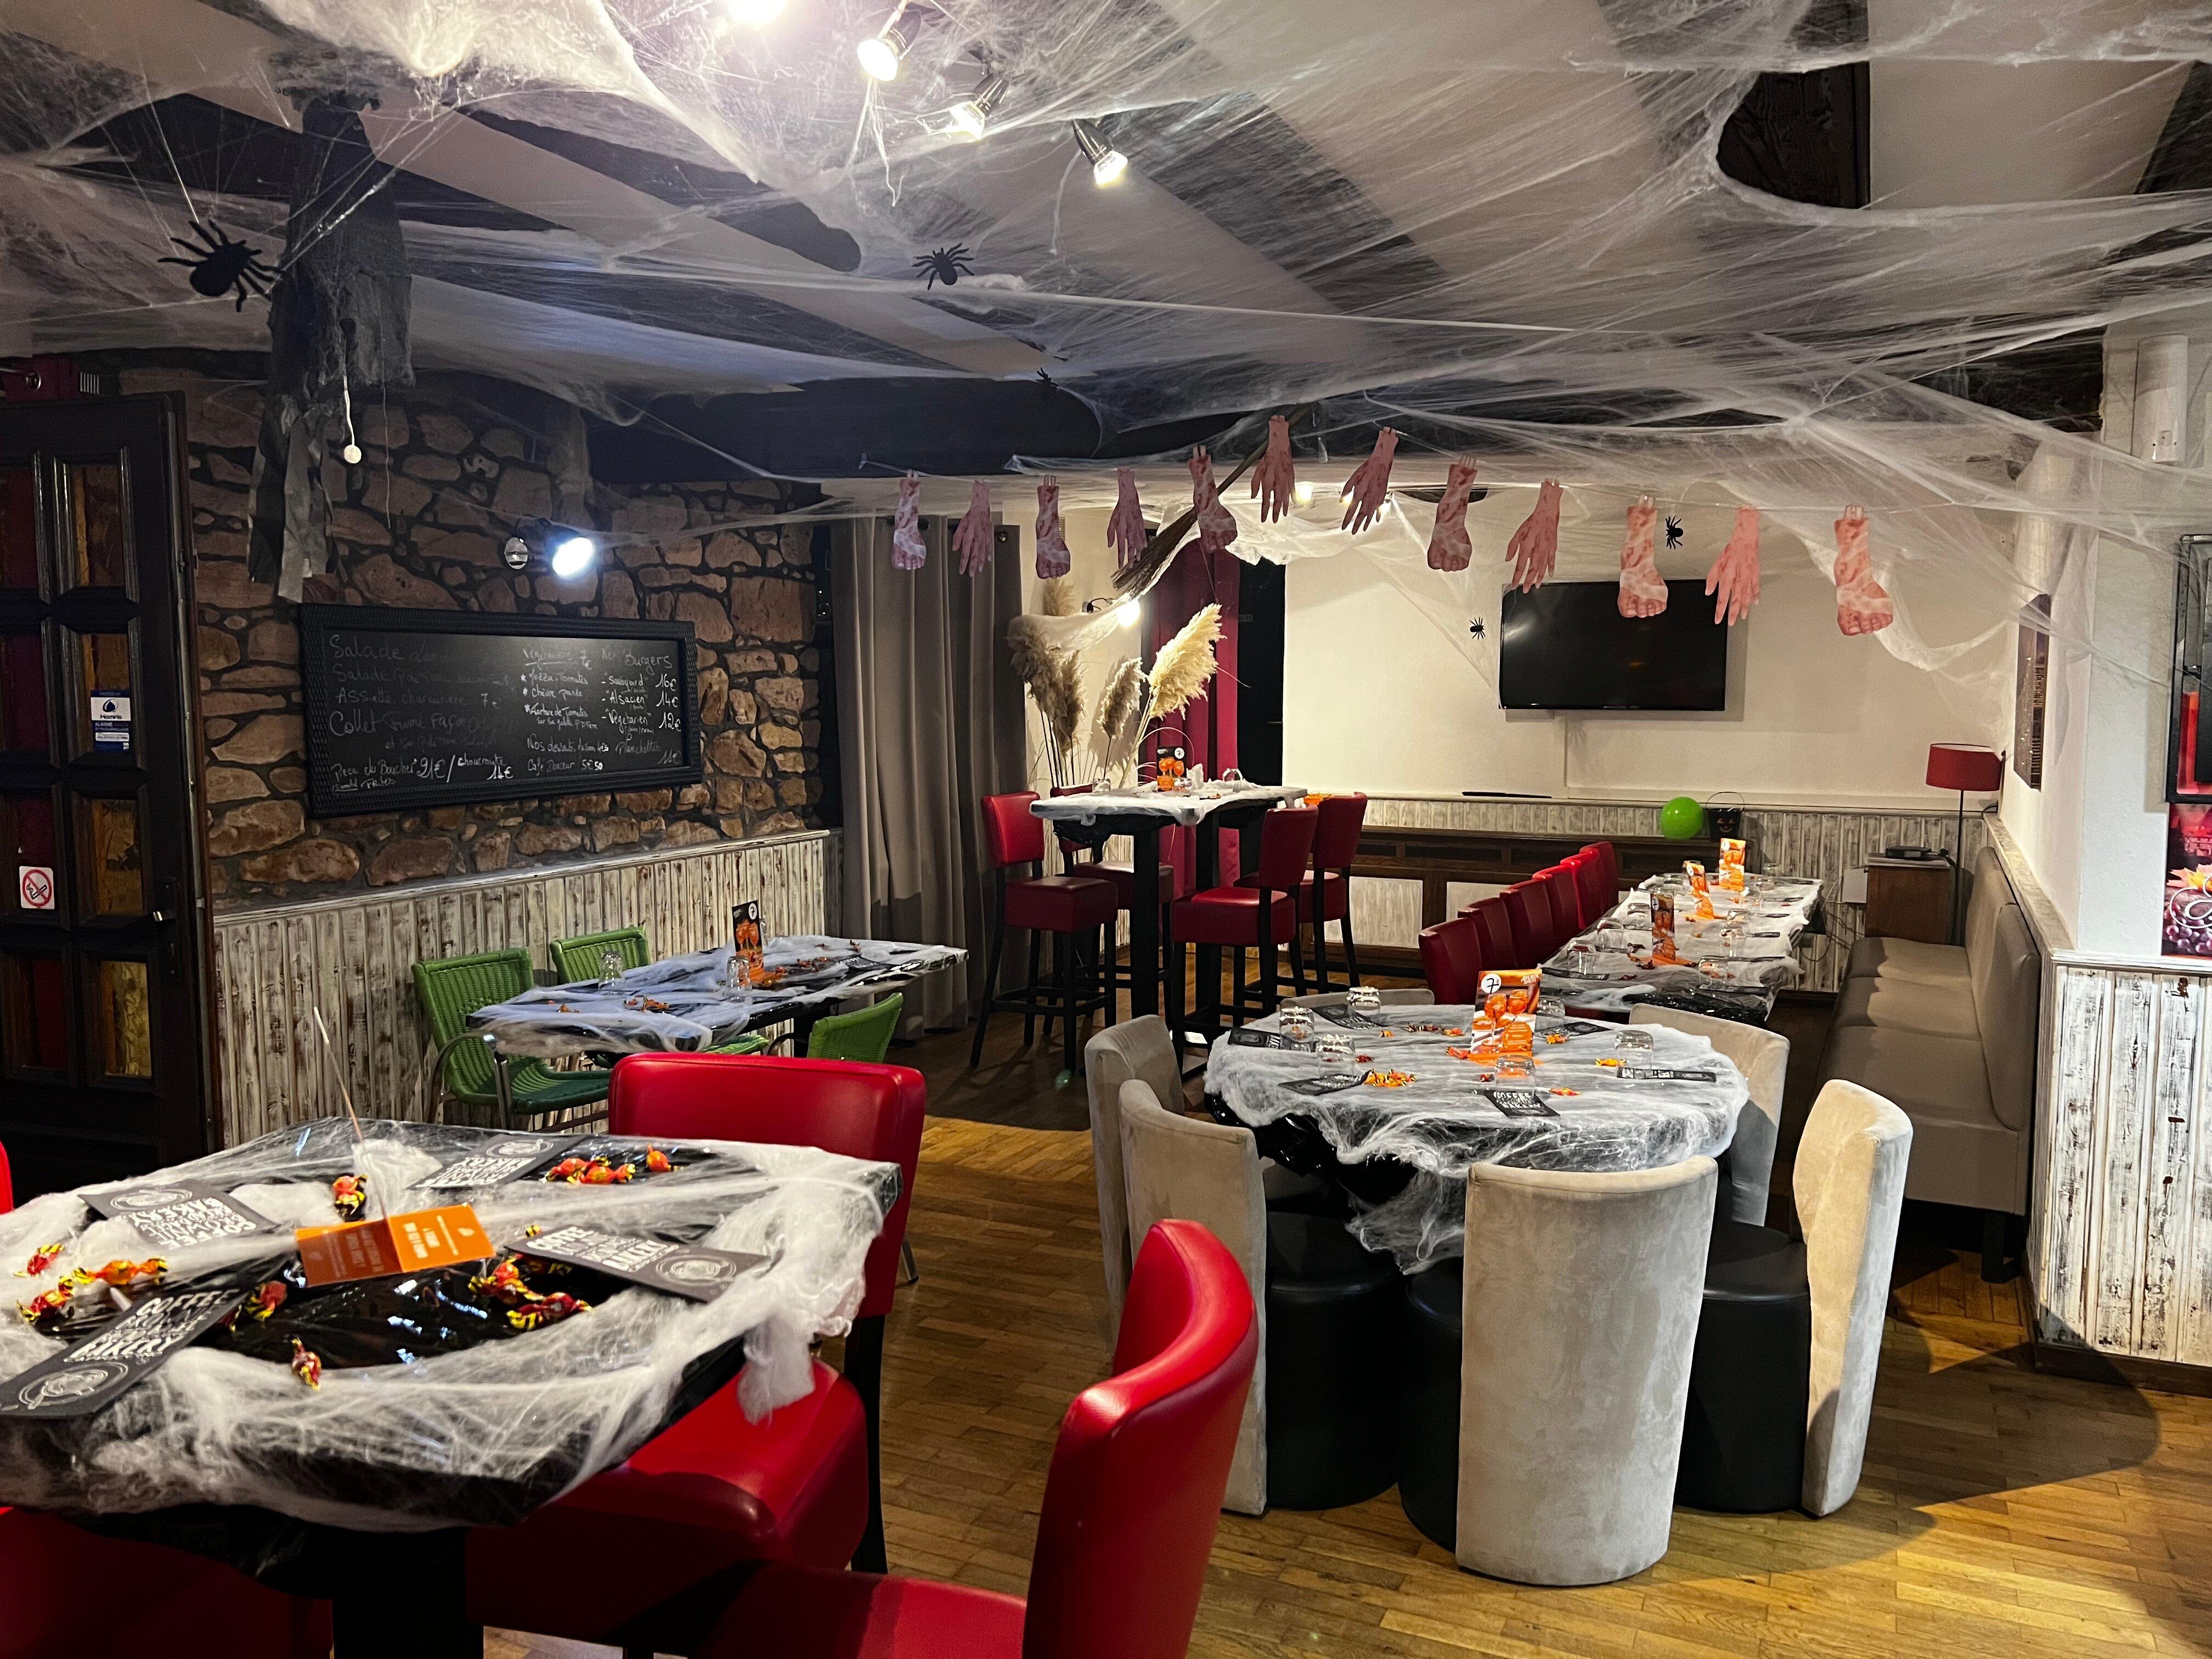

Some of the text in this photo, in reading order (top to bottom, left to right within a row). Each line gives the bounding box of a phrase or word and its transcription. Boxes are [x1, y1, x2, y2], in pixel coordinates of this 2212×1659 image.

[330, 634, 404, 660] Salade
[158, 1220, 257, 1250] COFFEE
[137, 1289, 240, 1316] COFFEE
